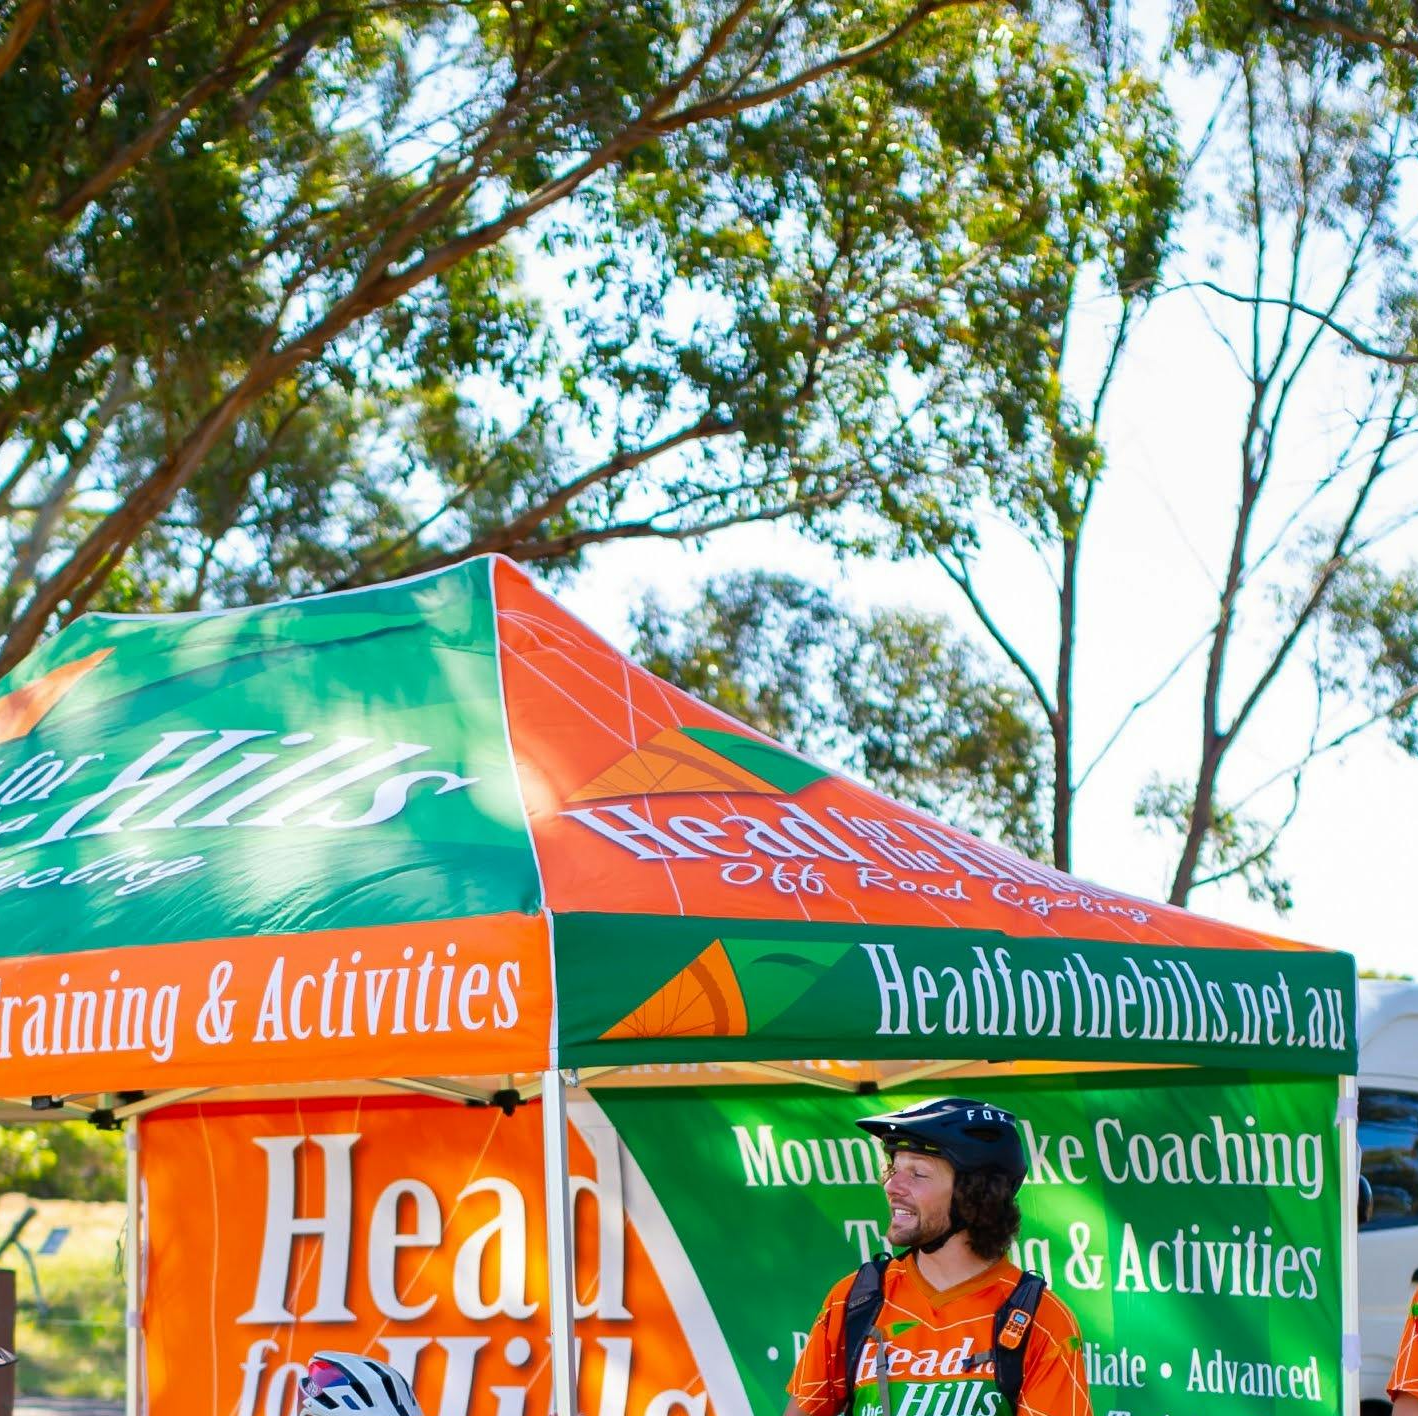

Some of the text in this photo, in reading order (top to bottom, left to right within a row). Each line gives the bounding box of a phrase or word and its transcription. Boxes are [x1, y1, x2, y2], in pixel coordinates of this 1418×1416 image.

[7, 728, 482, 848] Hills
[557, 800, 878, 865] Head
[825, 805, 898, 843] for
[867, 839, 958, 876] the
[719, 861, 1154, 926] Off Road Cycling
[195, 959, 238, 1045] &
[252, 942, 522, 1044] Activities
[857, 942, 1347, 1051] Headforthehills.net.au
[966, 1109, 1008, 1123] FOX
[1095, 1115, 1325, 1200] Coaching
[236, 1124, 636, 1325] Head
[1064, 1220, 1105, 1291] &
[1117, 1222, 1322, 1301] Activities
[1185, 1347, 1322, 1402] Advanced
